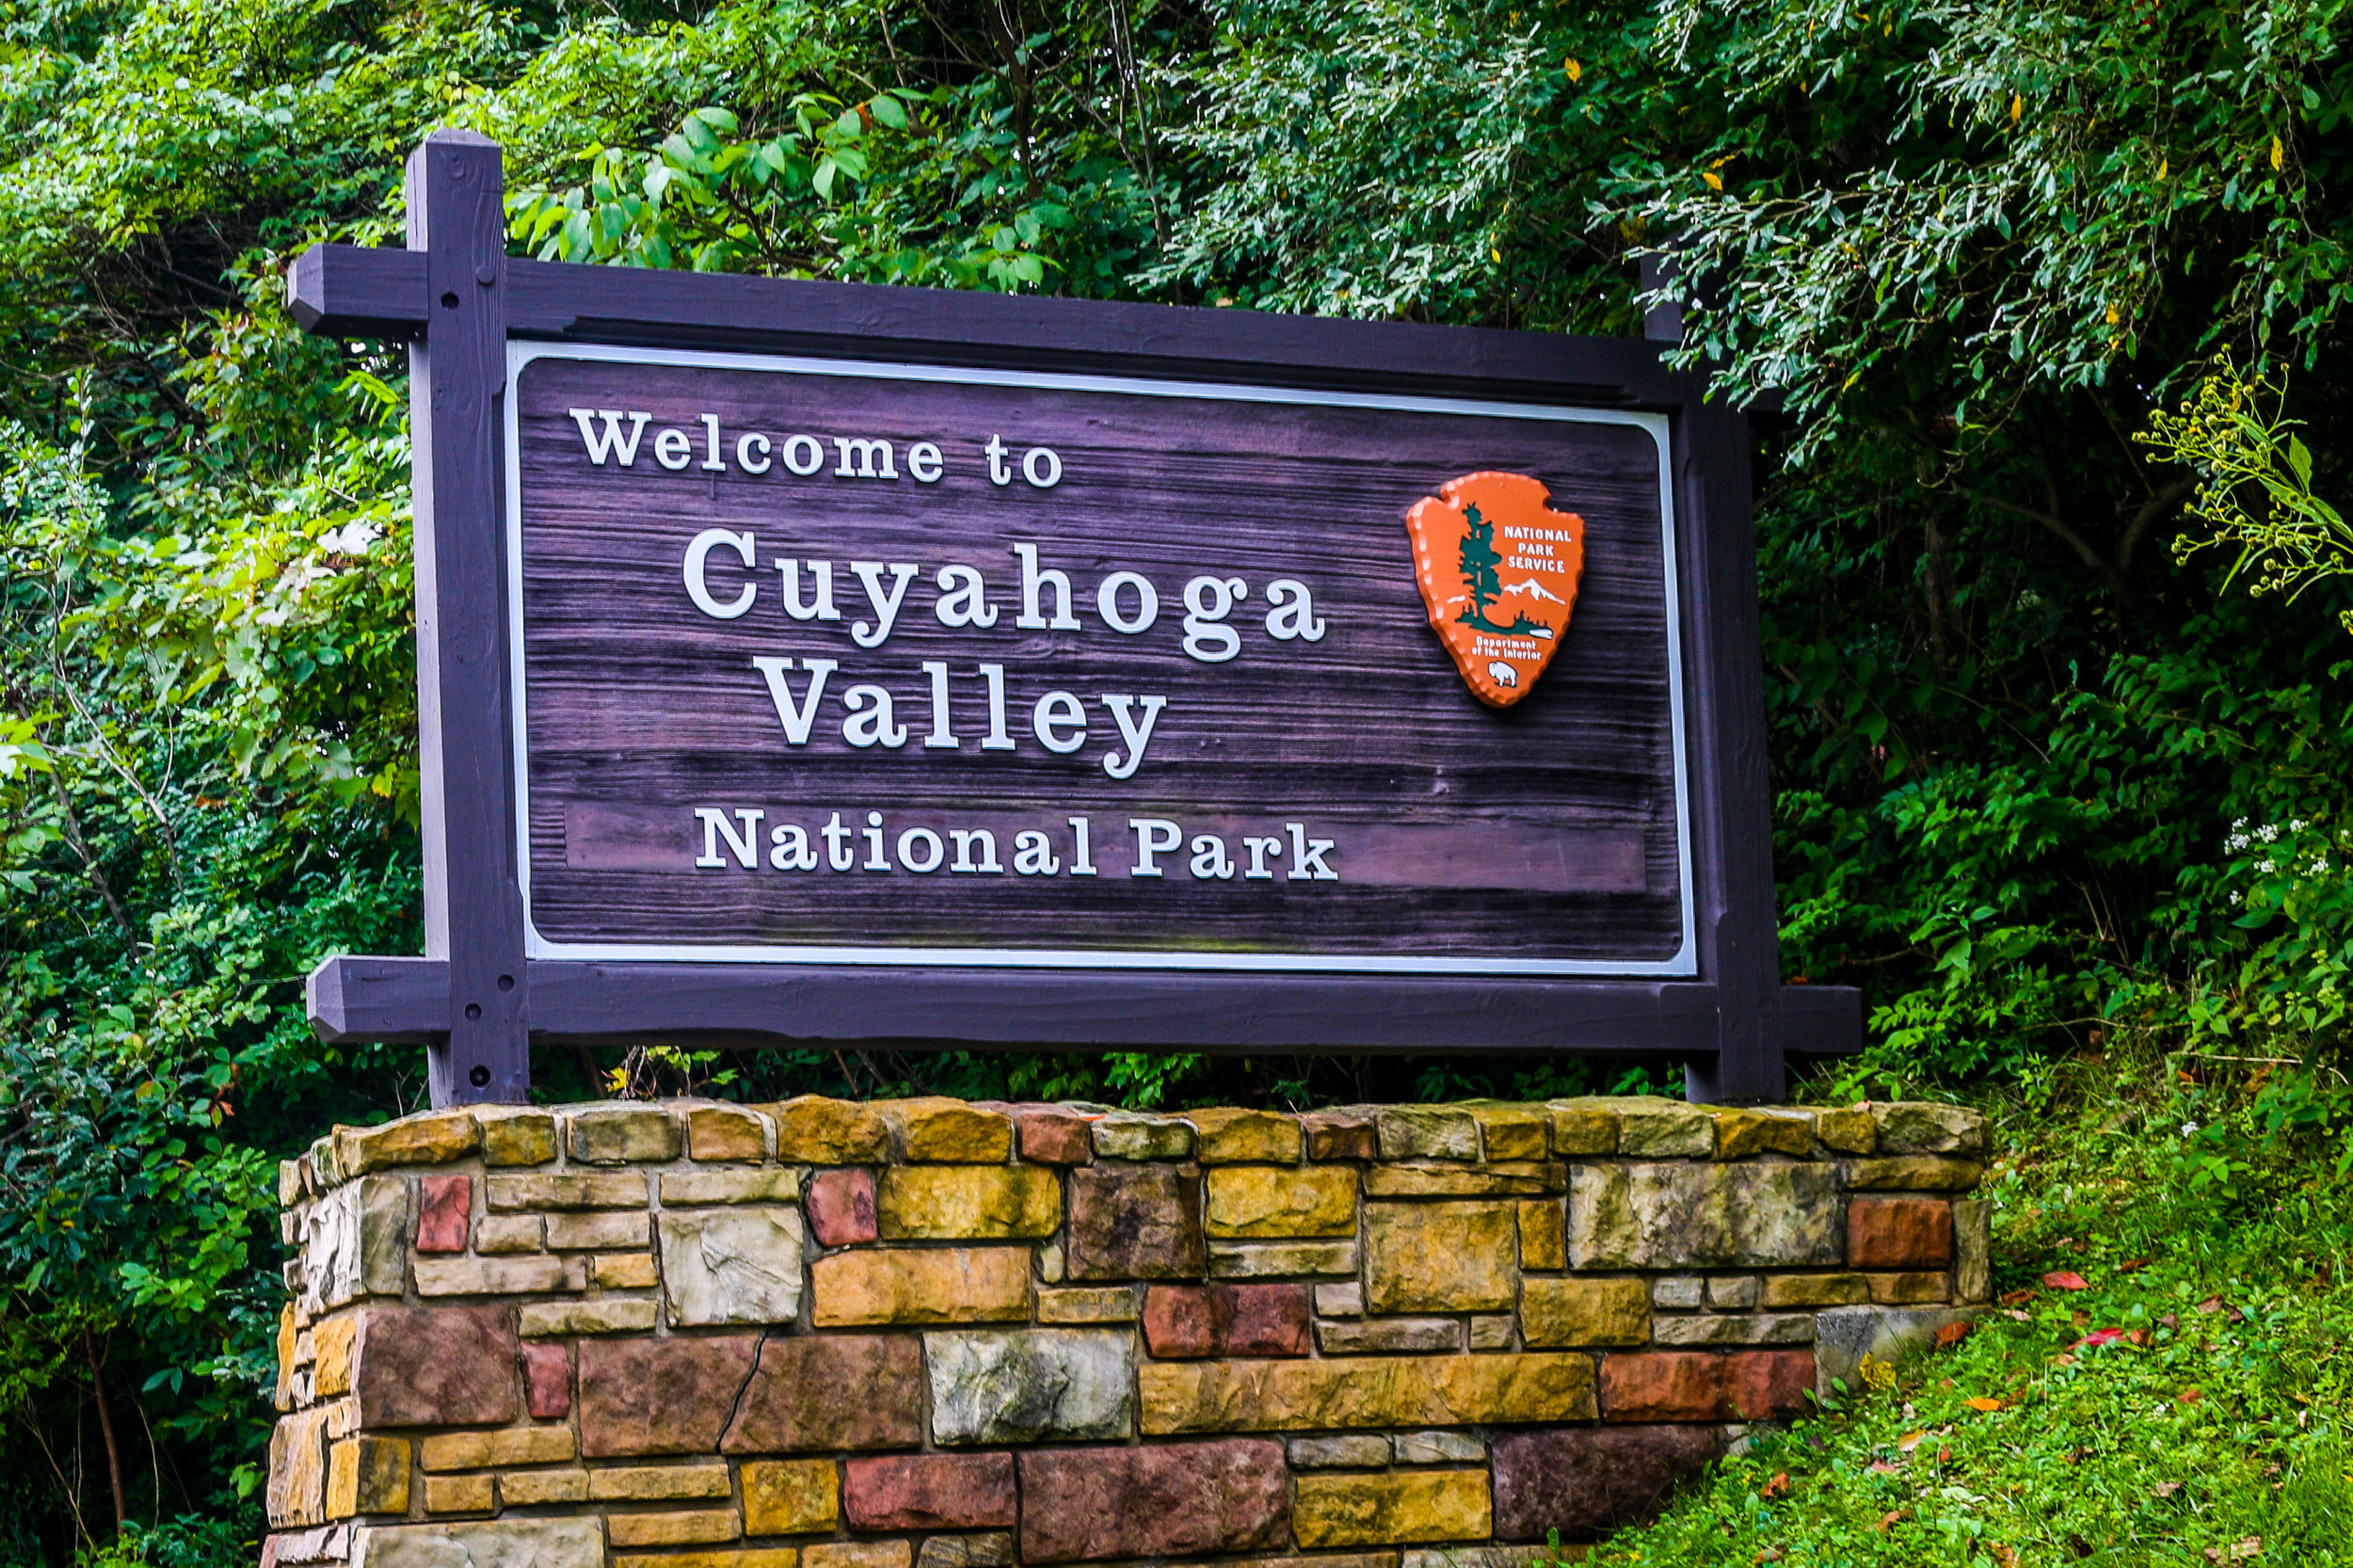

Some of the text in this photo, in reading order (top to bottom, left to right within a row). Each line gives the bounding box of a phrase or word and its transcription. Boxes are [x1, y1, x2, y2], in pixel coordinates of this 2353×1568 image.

[569, 408, 1064, 488] Welcome to
[1504, 525, 1572, 543] NATIONAL
[1518, 542, 1554, 556] PARK
[1508, 555, 1565, 573] SERVICE
[682, 527, 1326, 663] Cuyahoga
[1476, 635, 1536, 649] Department
[1471, 647, 1542, 661] of the Interior
[754, 656, 1167, 779] Valley
[694, 807, 1339, 882] National Park
